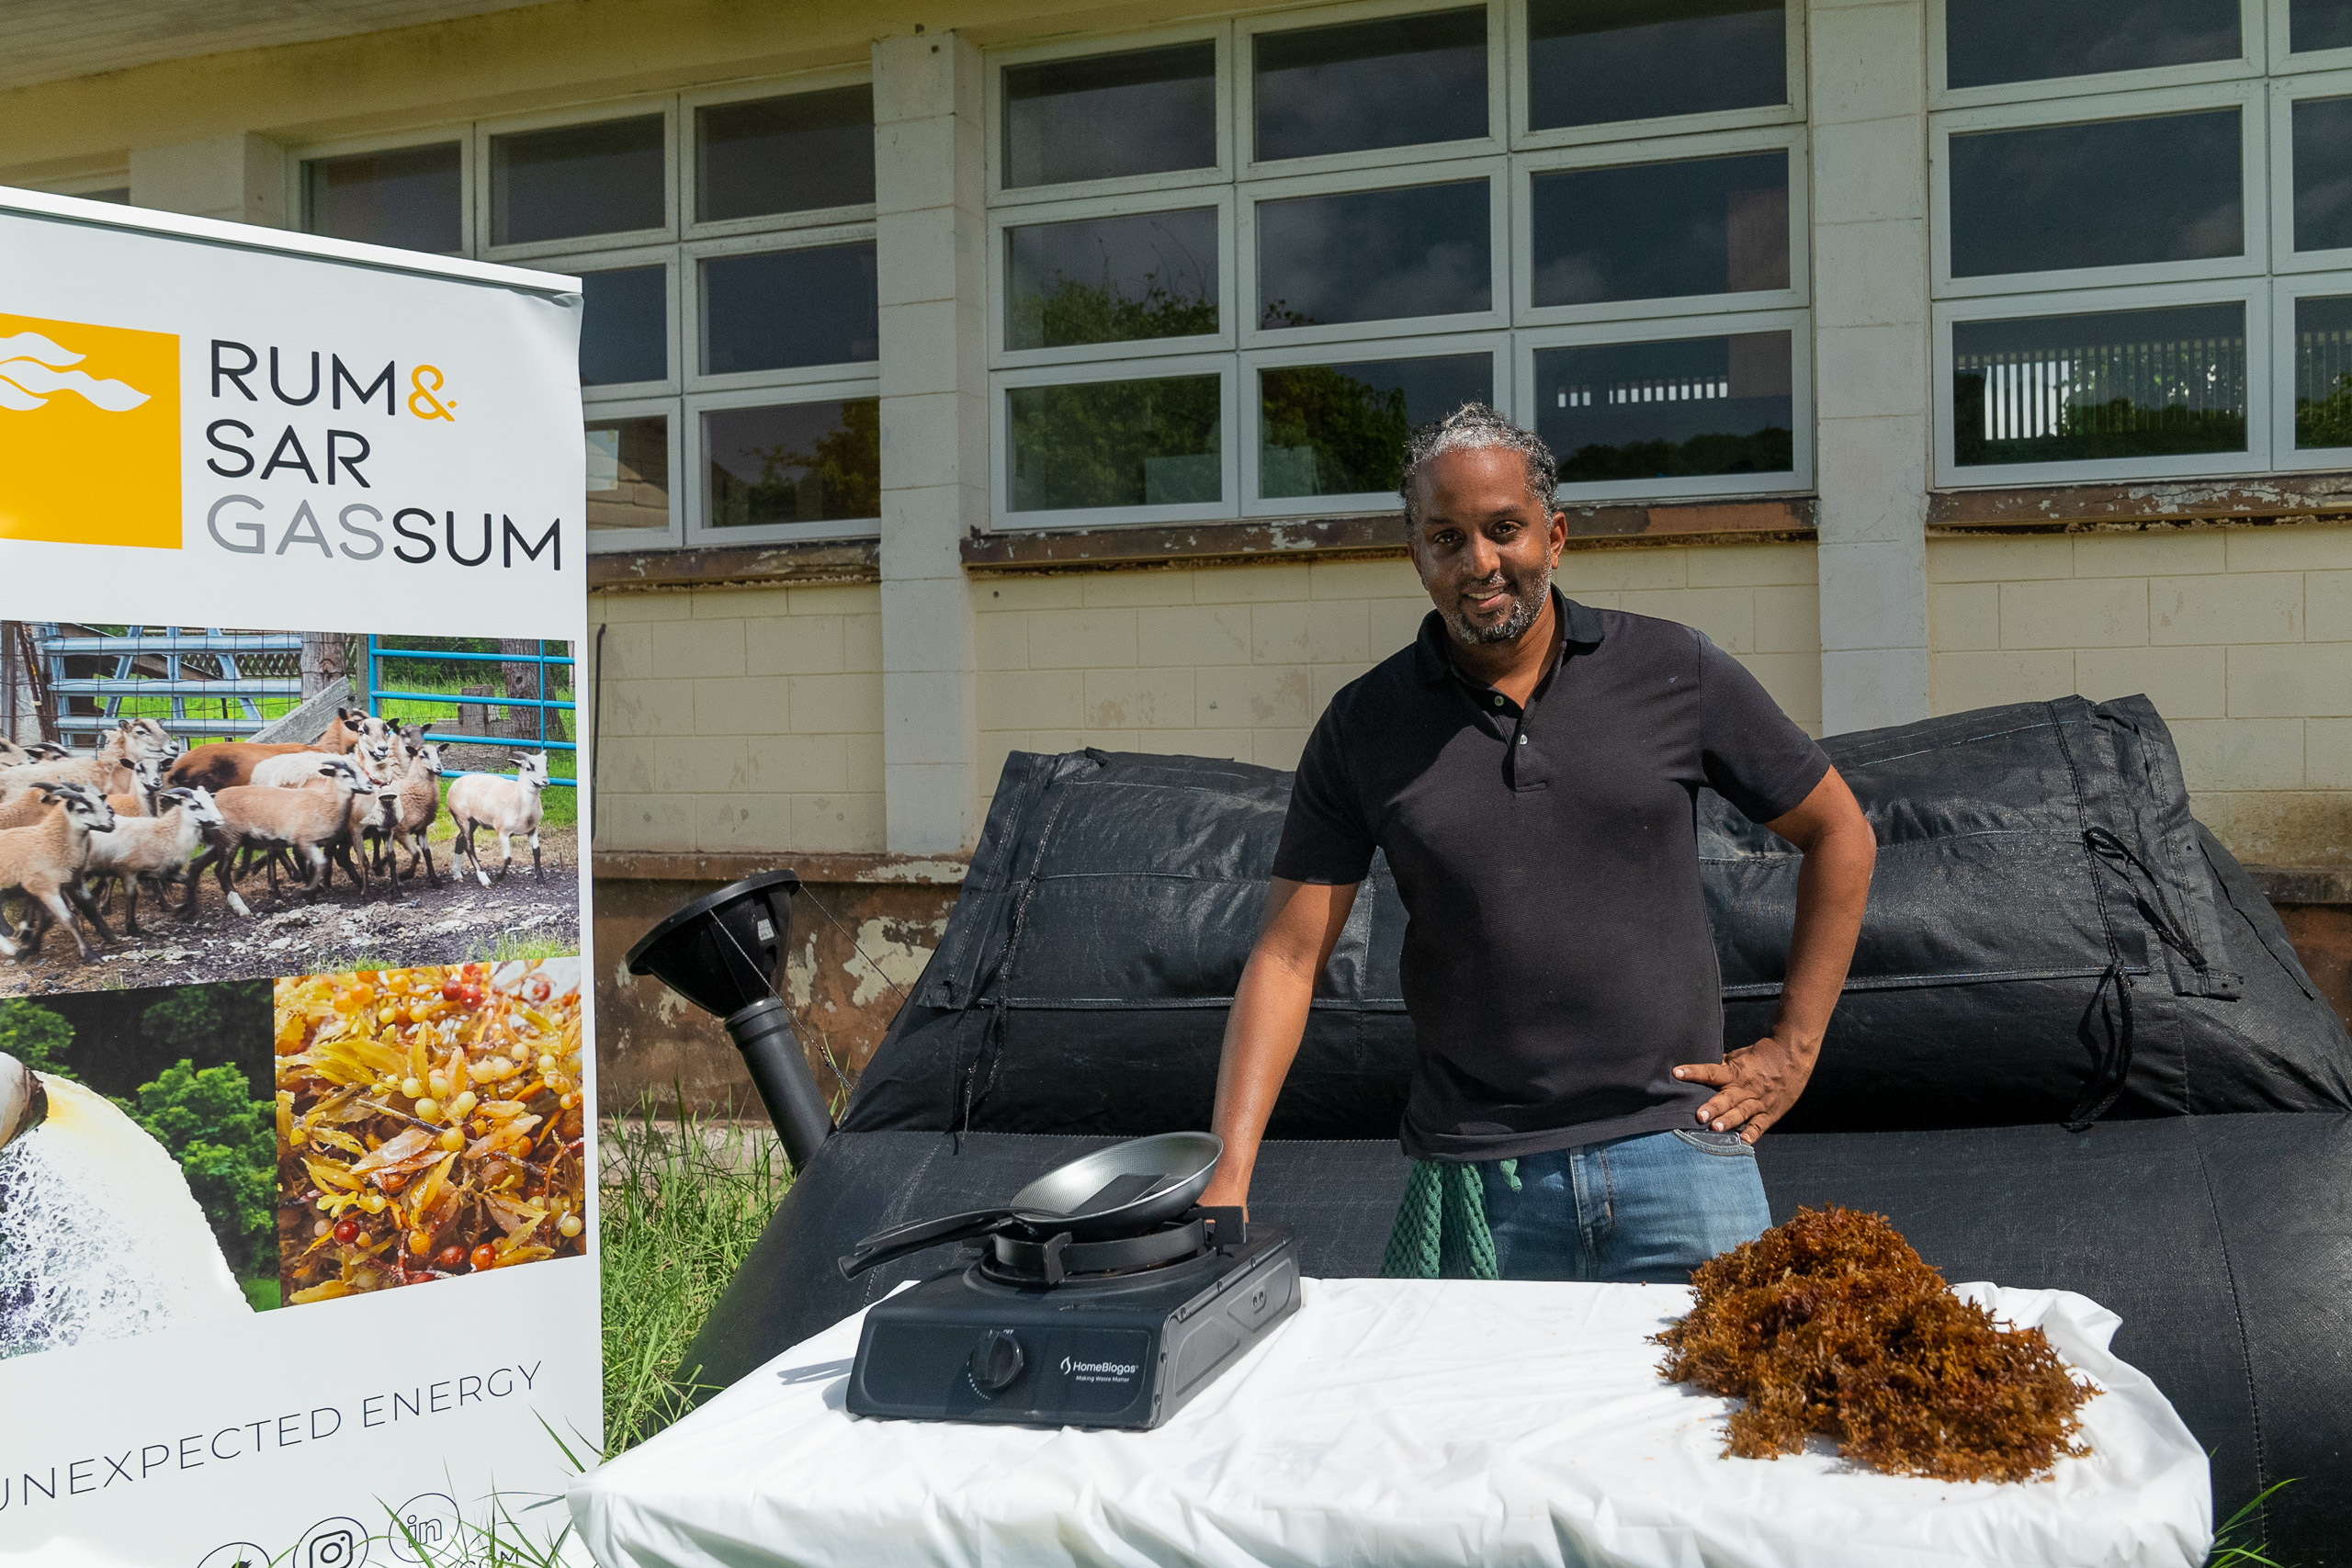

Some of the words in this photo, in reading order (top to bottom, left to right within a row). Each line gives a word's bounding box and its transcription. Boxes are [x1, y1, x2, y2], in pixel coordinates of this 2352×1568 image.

[210, 338, 458, 423] RUM&
[205, 418, 371, 489] SAR
[207, 493, 561, 571] GASSUM
[363, 1359, 542, 1428] ENERGY
